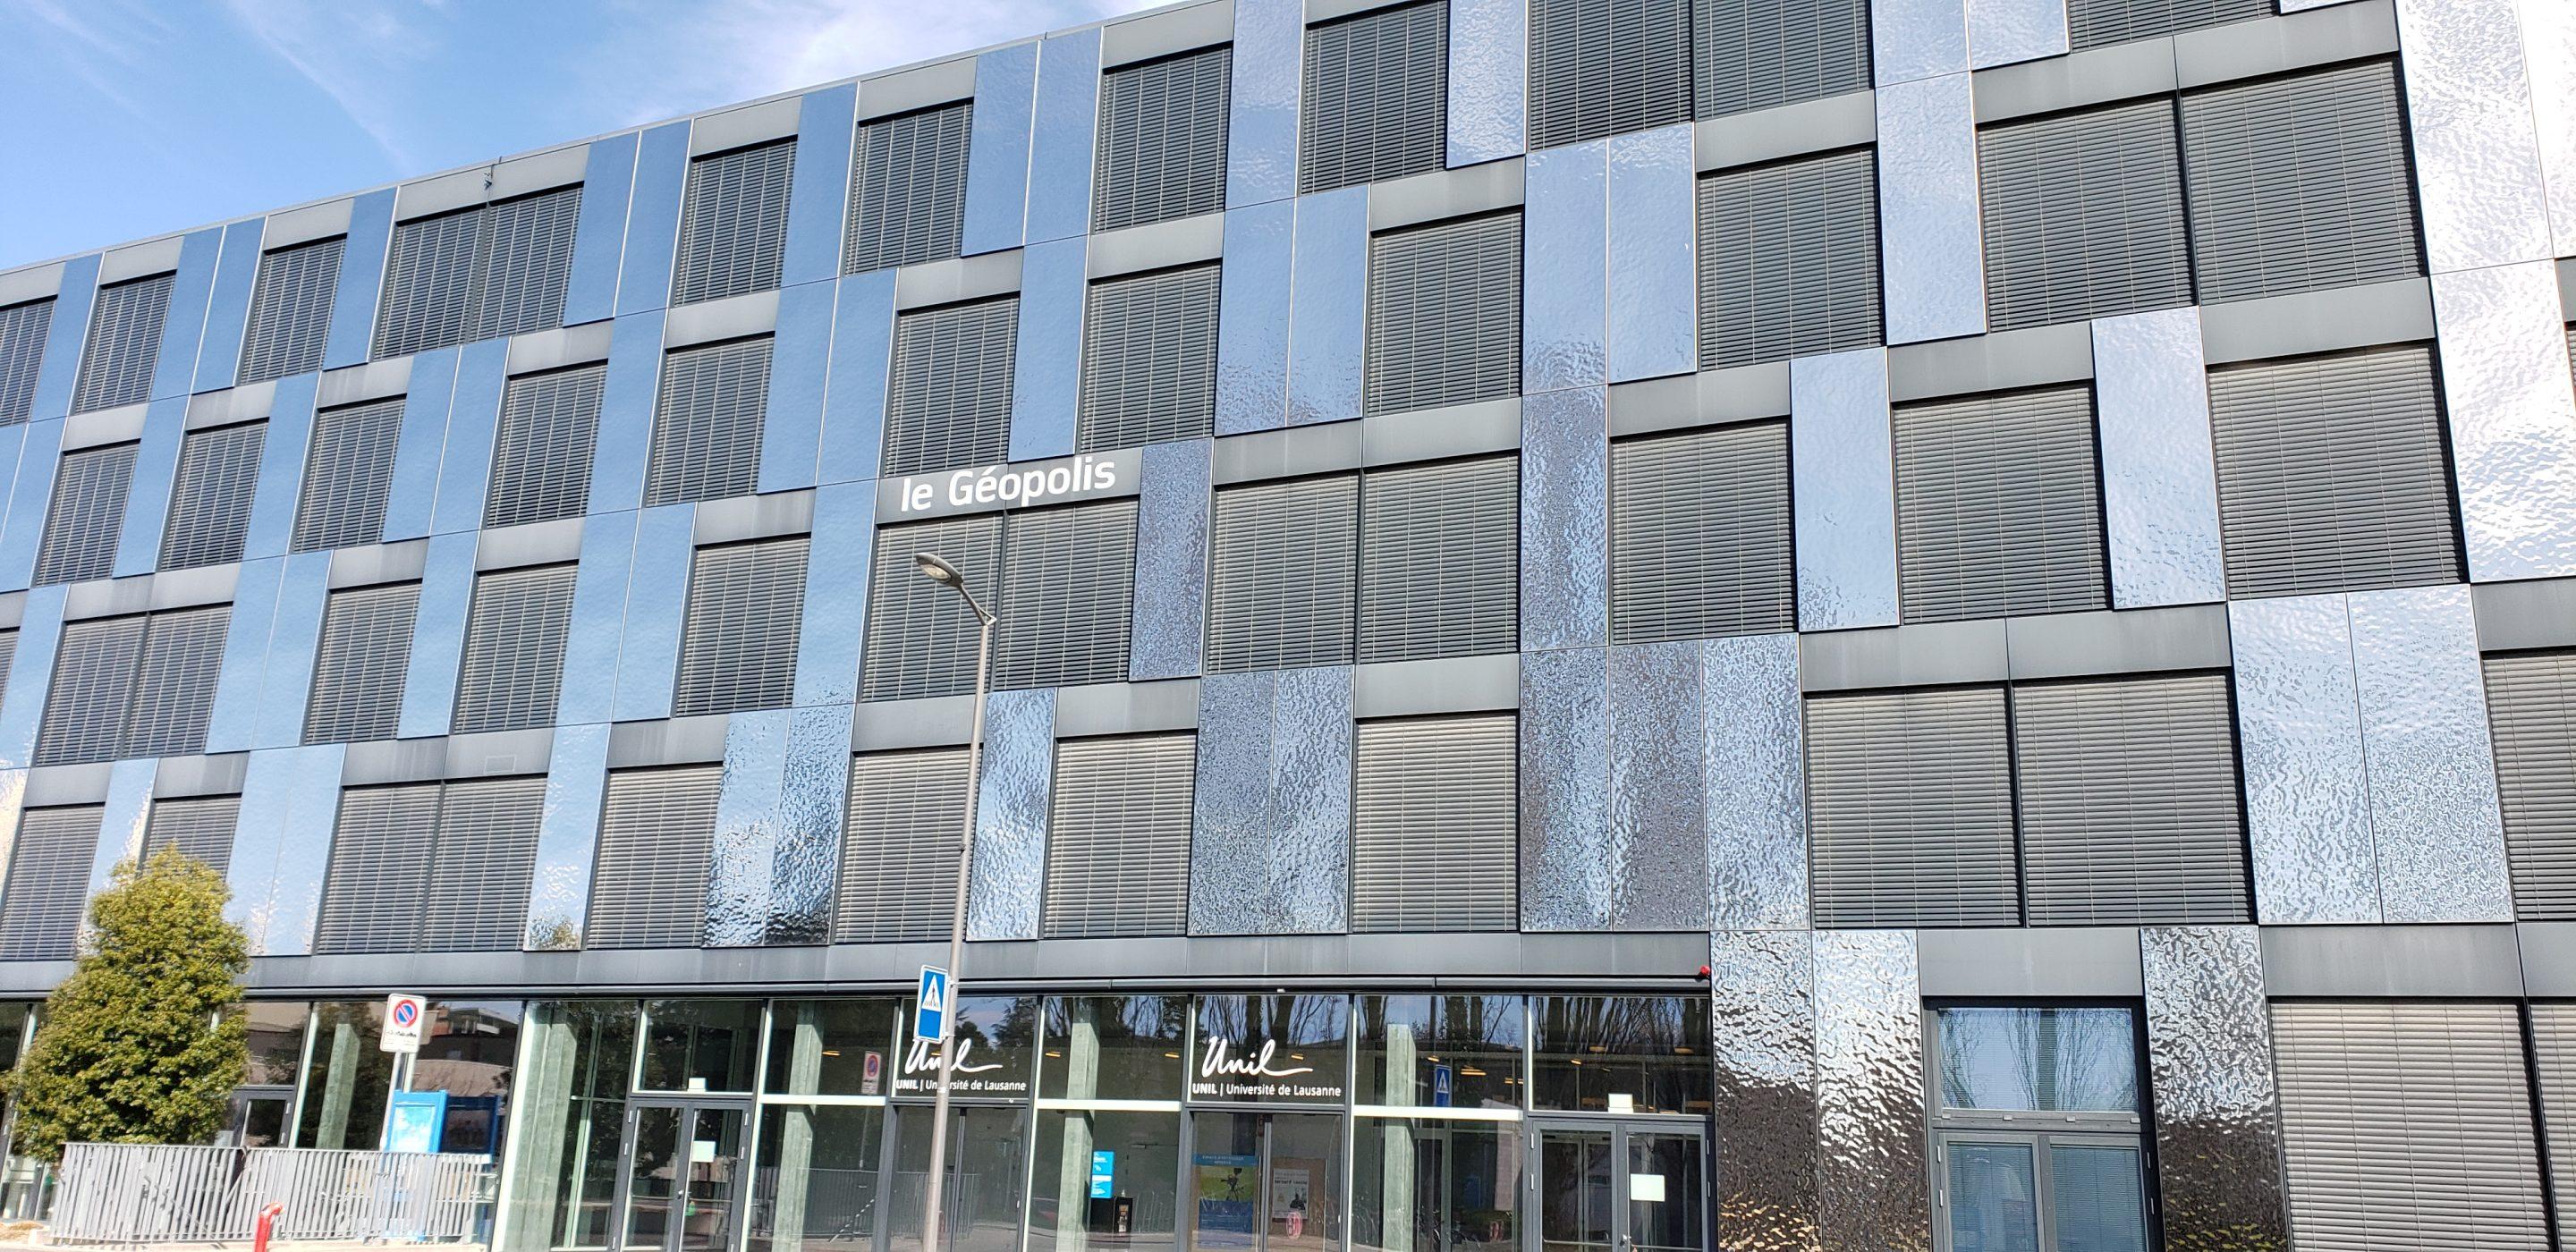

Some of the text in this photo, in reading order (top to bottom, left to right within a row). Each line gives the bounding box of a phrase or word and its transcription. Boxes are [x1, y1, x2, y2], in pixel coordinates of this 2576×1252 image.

[901, 455, 1116, 512] le Géopolis
[904, 1037, 1004, 1075] Unl
[1201, 1036, 1314, 1078] Unil
[895, 1079, 919, 1090] UNIL
[925, 1079, 970, 1090] Unrsité
[970, 1079, 983, 1090] de
[984, 1079, 1027, 1091] Lausanne
[1192, 1082, 1217, 1095] UNIL
[1226, 1083, 1275, 1096] Université
[1277, 1083, 1292, 1096] de
[1293, 1084, 1342, 1097] Lausanne
